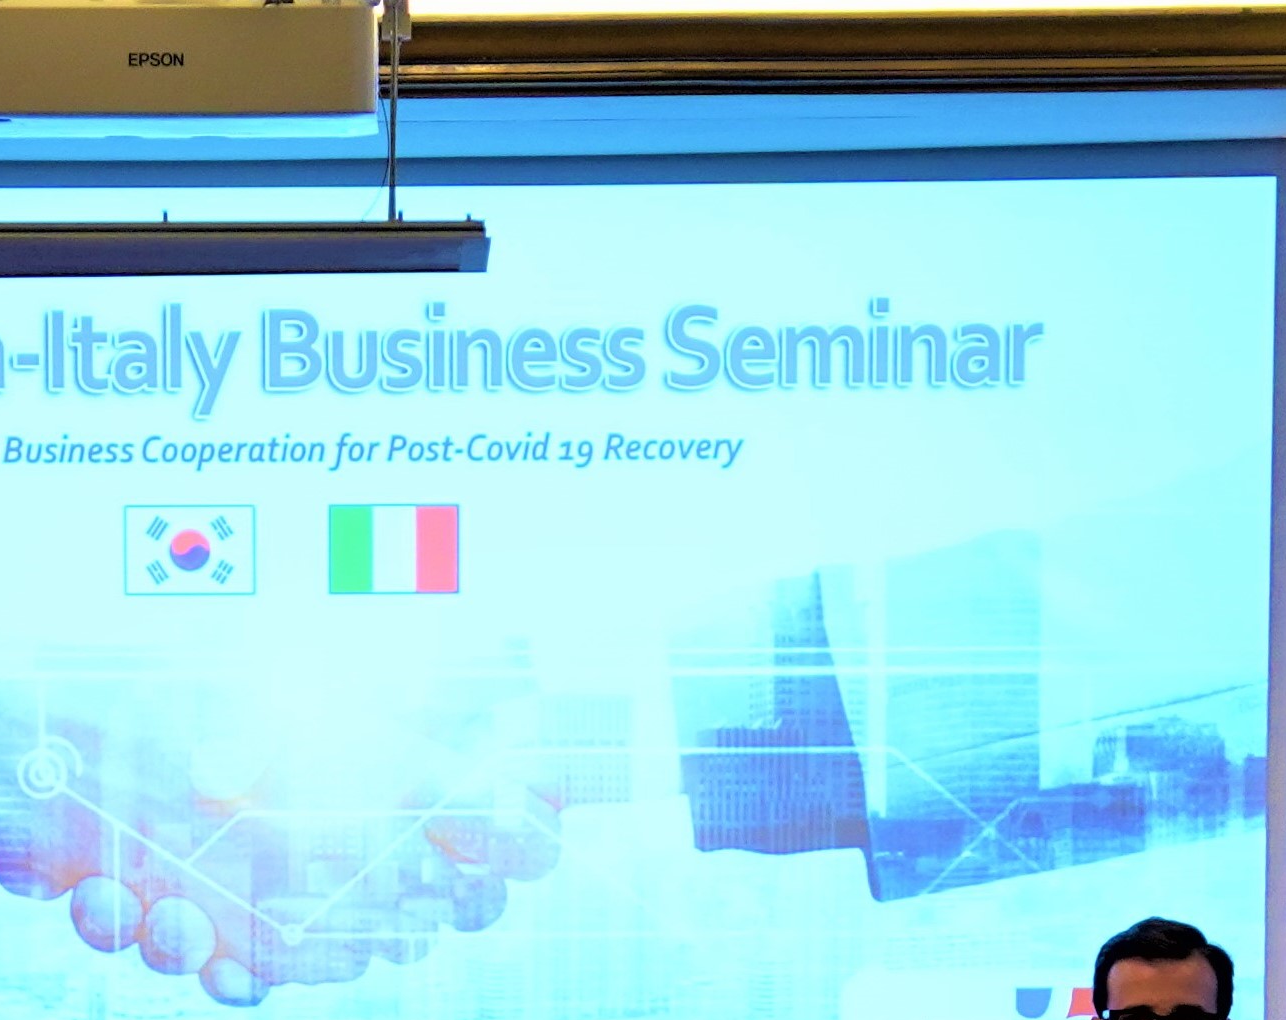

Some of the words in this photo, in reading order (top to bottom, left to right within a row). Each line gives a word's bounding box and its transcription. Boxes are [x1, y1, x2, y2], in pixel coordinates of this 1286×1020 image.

[128, 52, 185, 67] EPSON
[260, 300, 647, 394] Business
[663, 296, 1045, 391] Seminar
[2, 434, 135, 464] Business
[141, 433, 326, 472] Cooperation
[328, 432, 381, 472] for
[386, 431, 551, 463] Post-Covid
[557, 438, 594, 469] 19
[602, 432, 745, 470] Recovery
